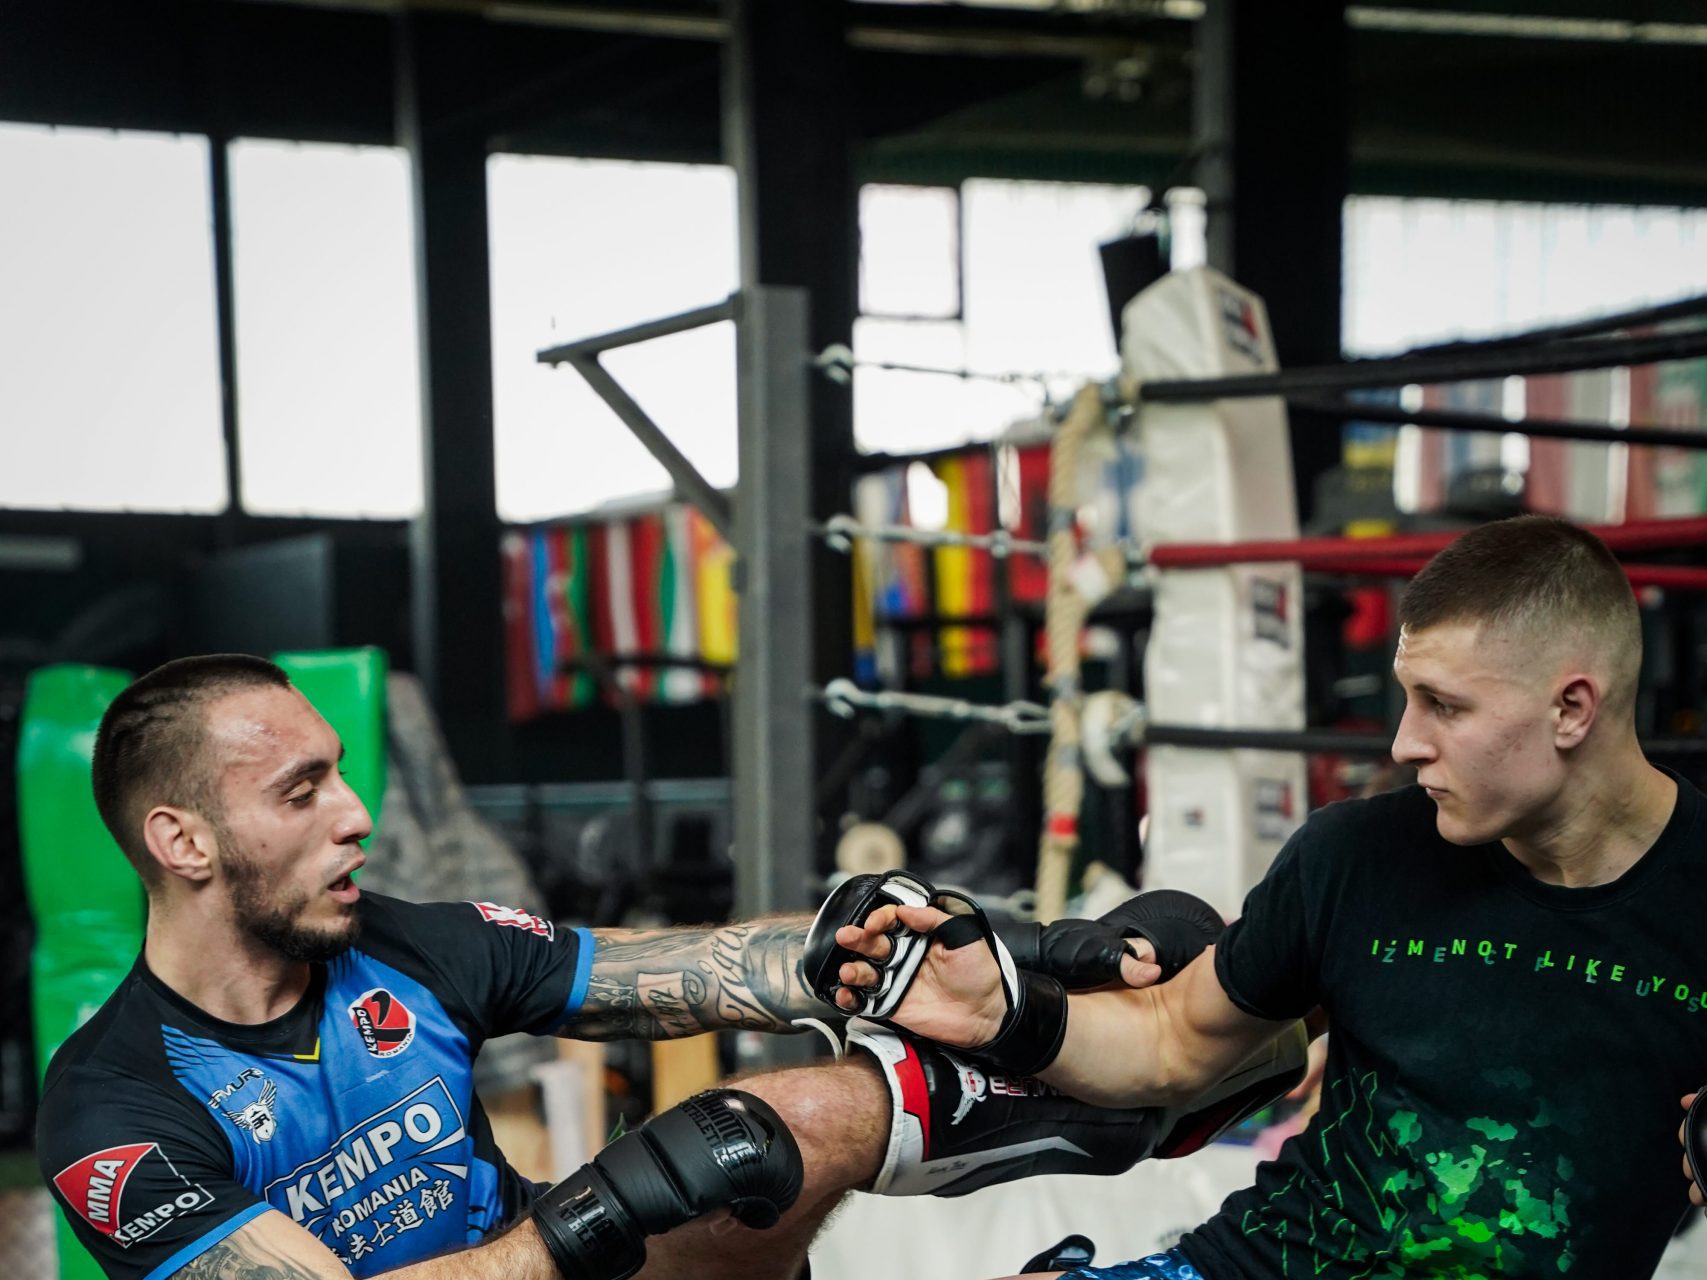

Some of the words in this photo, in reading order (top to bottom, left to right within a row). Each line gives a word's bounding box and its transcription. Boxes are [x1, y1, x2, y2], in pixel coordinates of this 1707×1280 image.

[1452, 938, 1518, 961] NOT
[1543, 949, 1626, 983] LIKE
[356, 1009, 378, 1052] KEMPO
[379, 1032, 414, 1057] ROMANIA
[285, 1102, 443, 1223] KEMPO
[87, 1159, 127, 1224] MMA
[331, 1166, 430, 1238] ROMANIA
